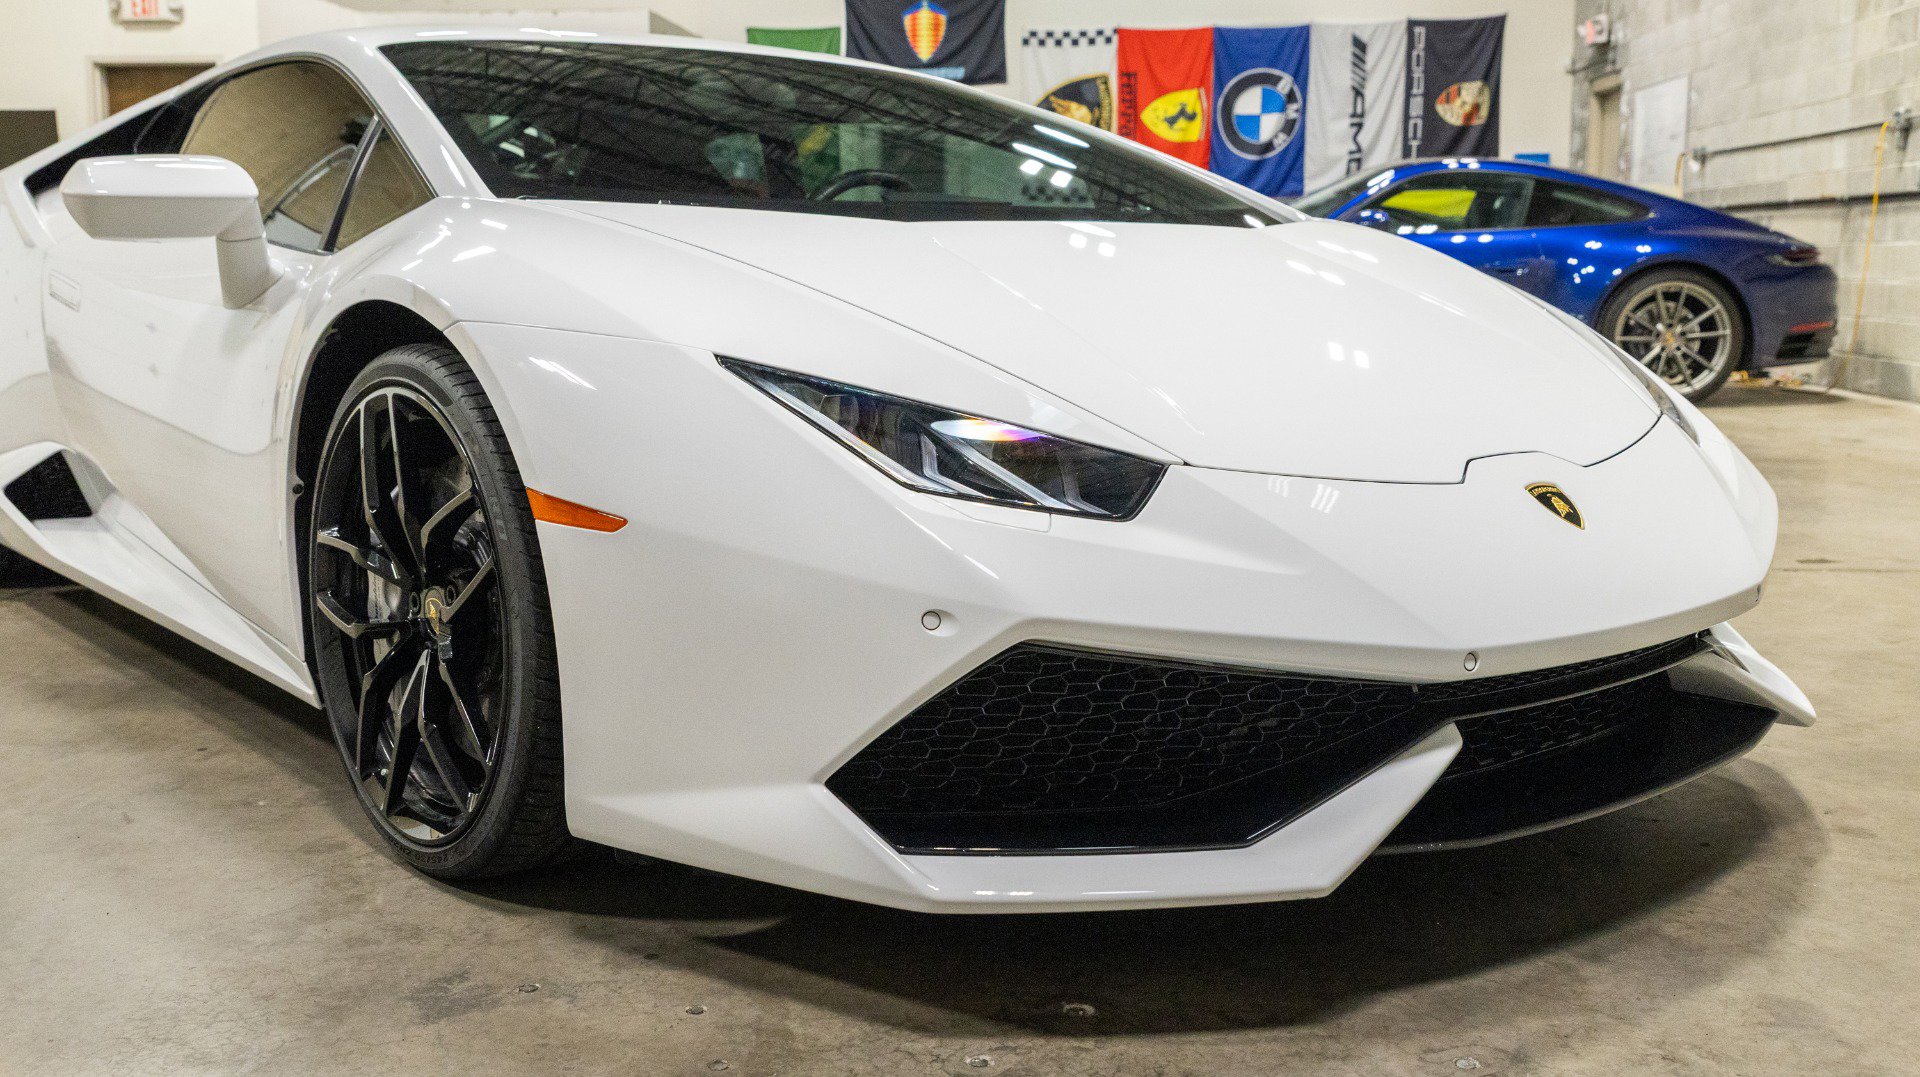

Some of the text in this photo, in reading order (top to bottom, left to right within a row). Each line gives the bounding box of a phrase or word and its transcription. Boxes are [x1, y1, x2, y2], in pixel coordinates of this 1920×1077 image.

[131, 0, 159, 17] EXIT
[1121, 72, 1137, 138] Ferra
[1274, 76, 1300, 148] BMW
[1408, 26, 1425, 158] PORSCH
